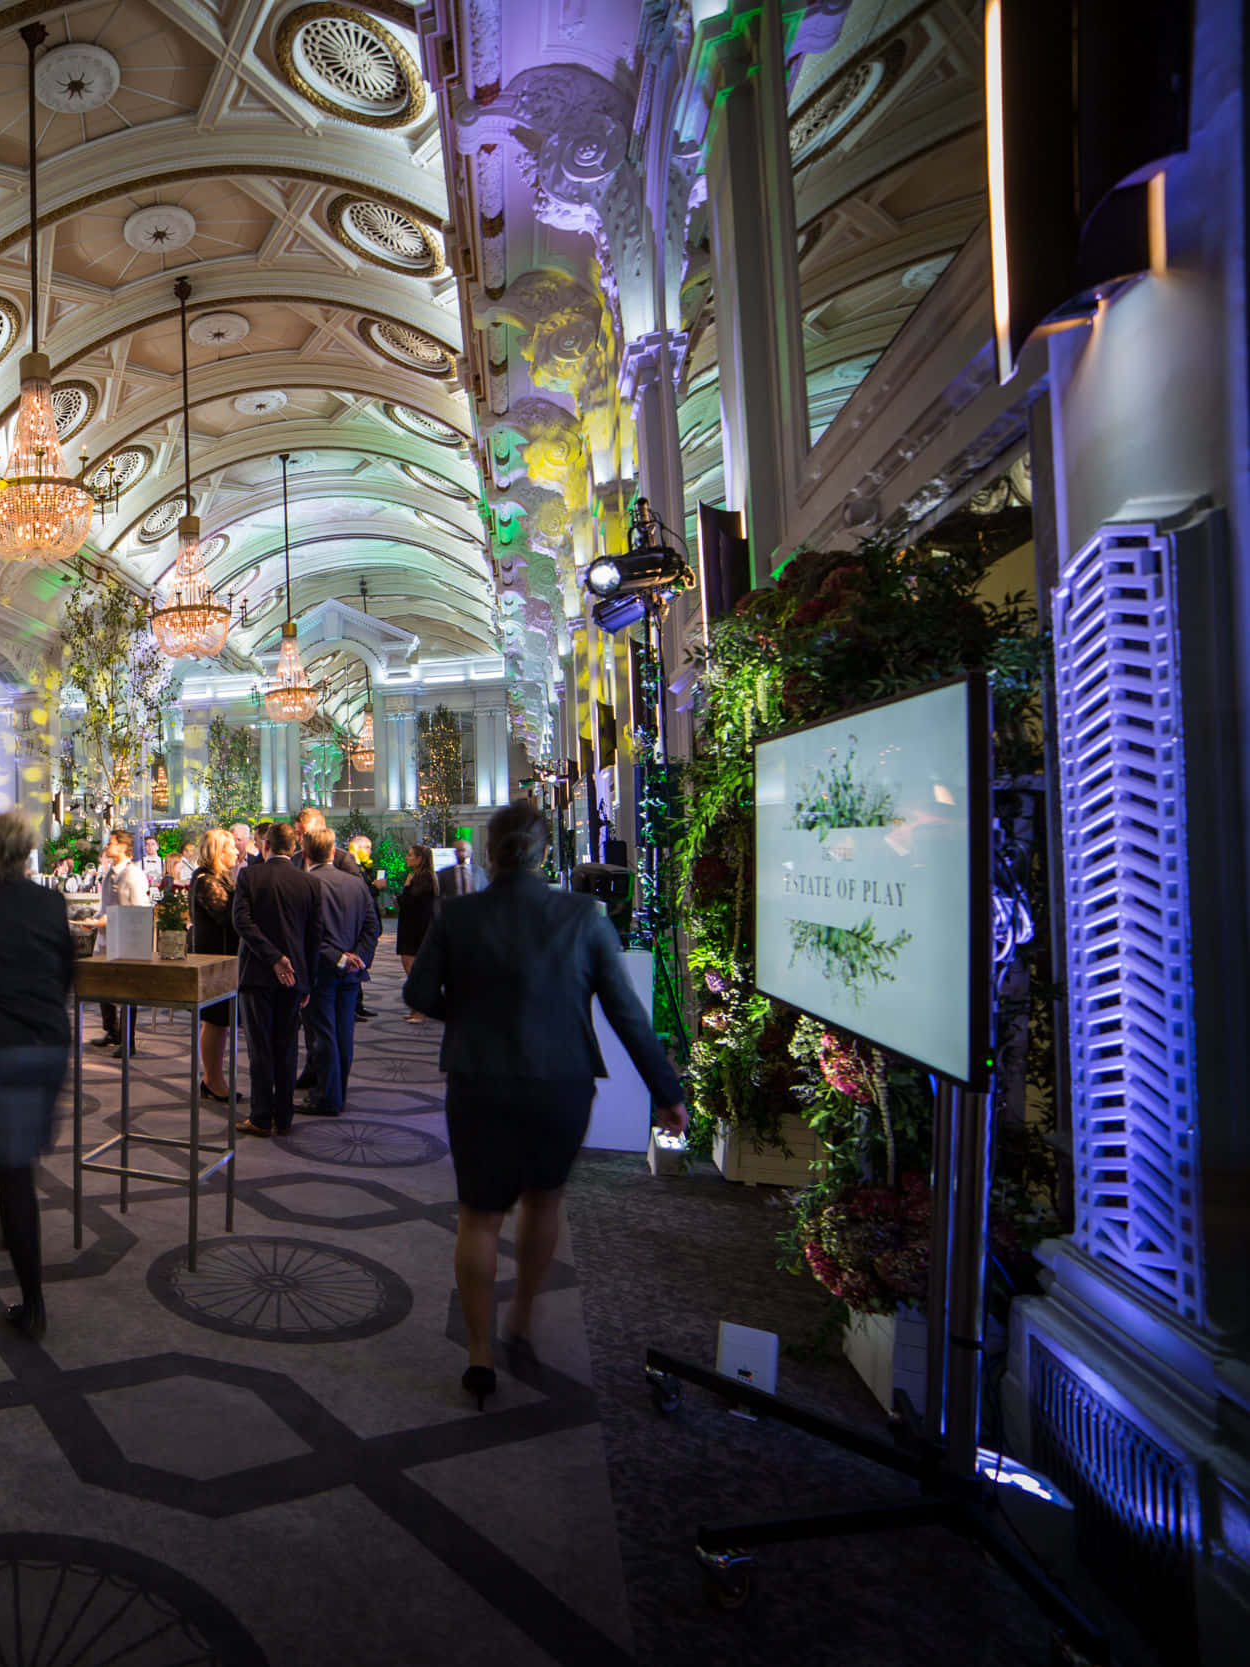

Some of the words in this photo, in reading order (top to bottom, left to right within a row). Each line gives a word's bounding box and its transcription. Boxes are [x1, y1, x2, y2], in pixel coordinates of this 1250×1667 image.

[784, 873, 831, 897] ESTATE
[837, 878, 855, 900] OF
[863, 880, 906, 907] PLAY
